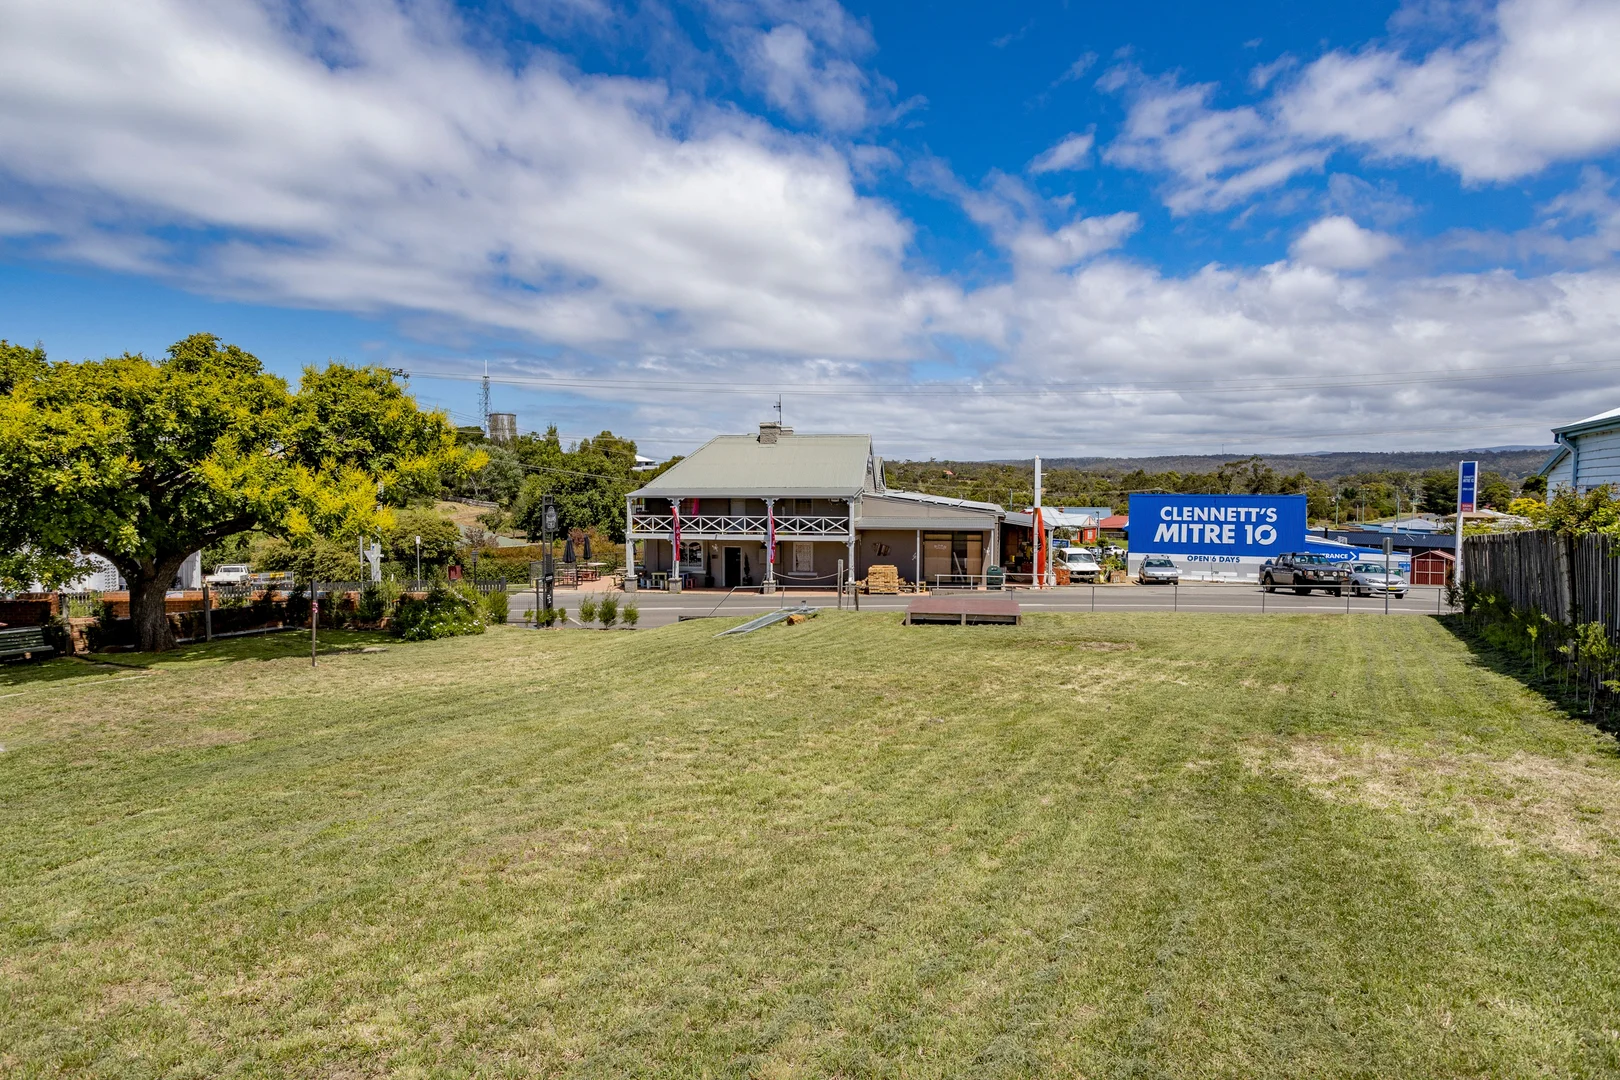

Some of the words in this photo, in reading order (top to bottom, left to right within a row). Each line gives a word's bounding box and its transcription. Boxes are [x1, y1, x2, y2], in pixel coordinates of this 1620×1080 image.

[1160, 506, 1278, 523] CLENNETT'S
[1153, 523, 1236, 545] MITRE
[1244, 524, 1277, 546] 10
[1317, 552, 1349, 560] TRANCE
